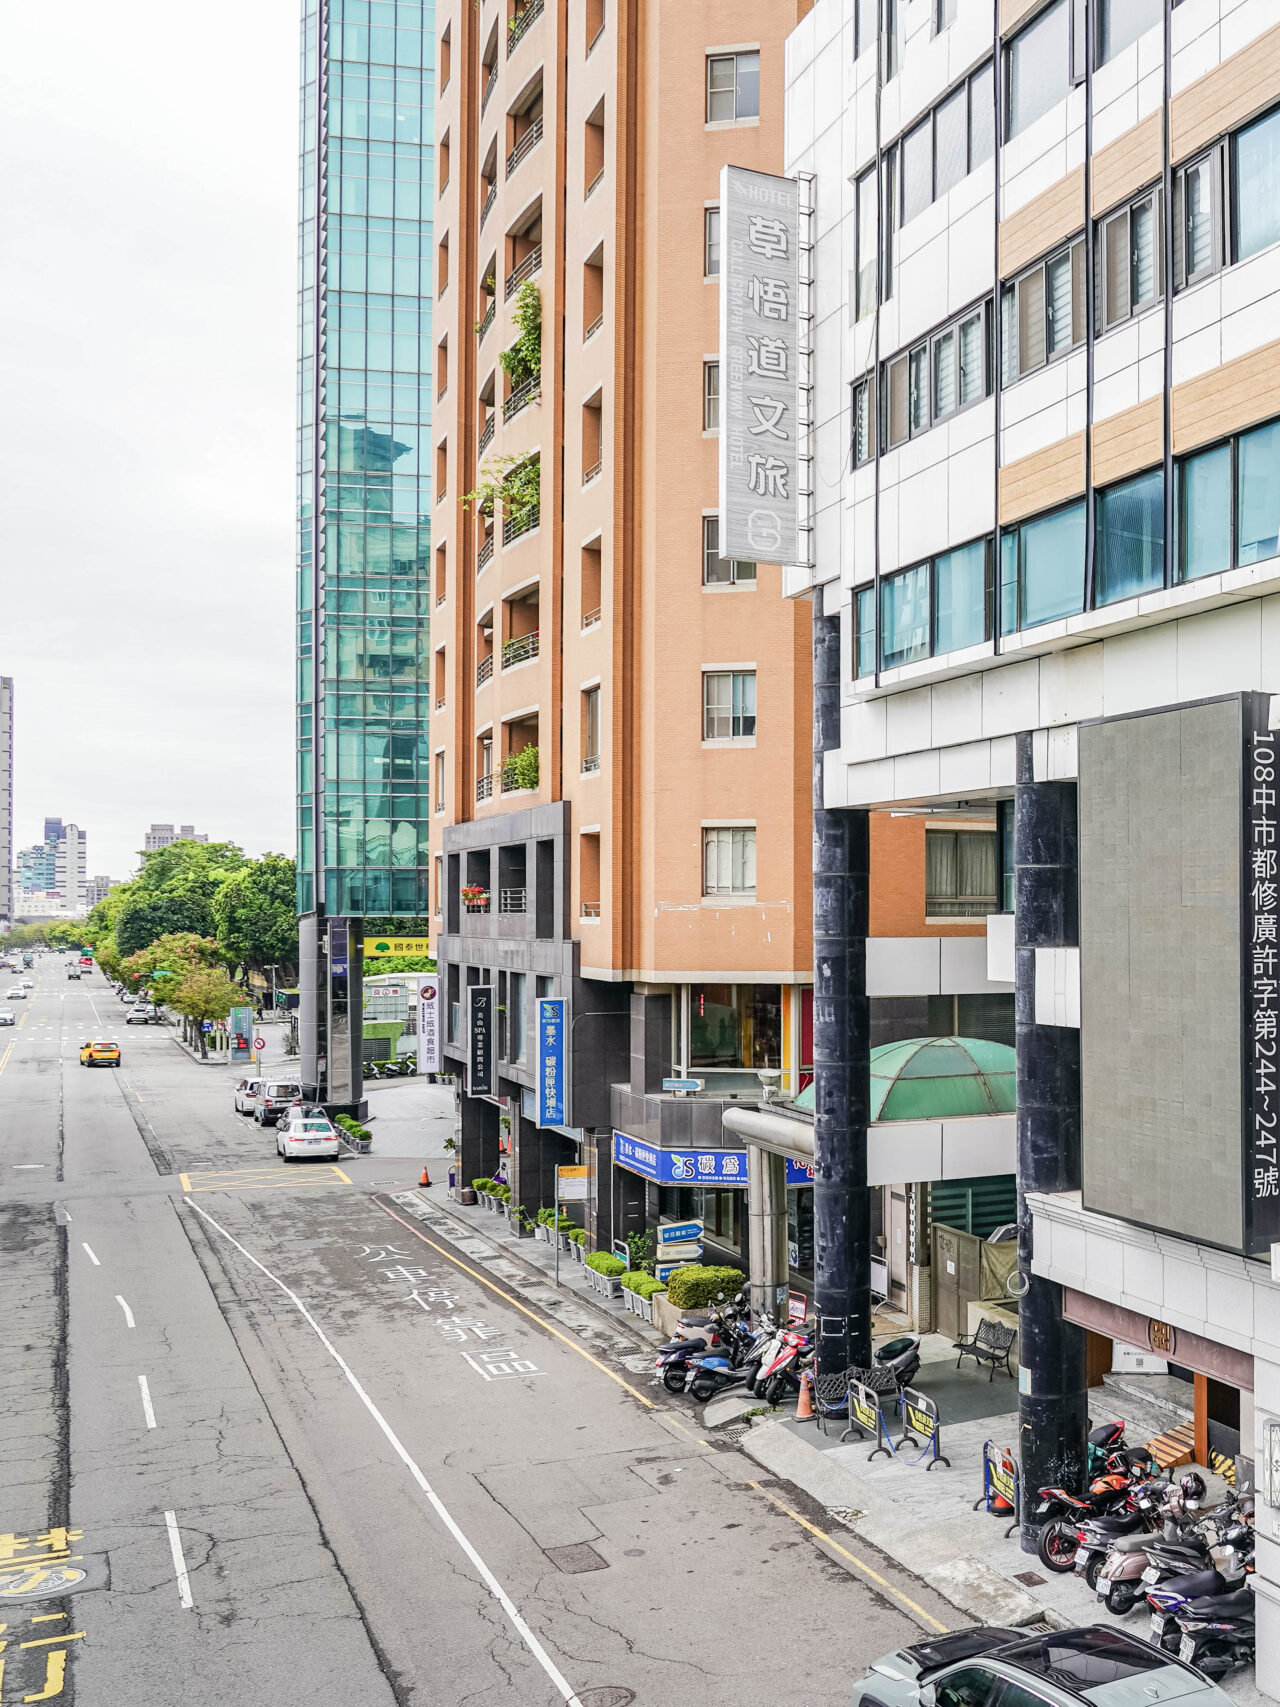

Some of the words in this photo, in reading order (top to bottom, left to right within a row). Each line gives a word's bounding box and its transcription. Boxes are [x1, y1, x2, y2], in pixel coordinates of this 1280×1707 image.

[745, 184, 796, 208] HOTEL
[746, 214, 790, 499] 草悟道文旅
[394, 943, 429, 952] 國泰世
